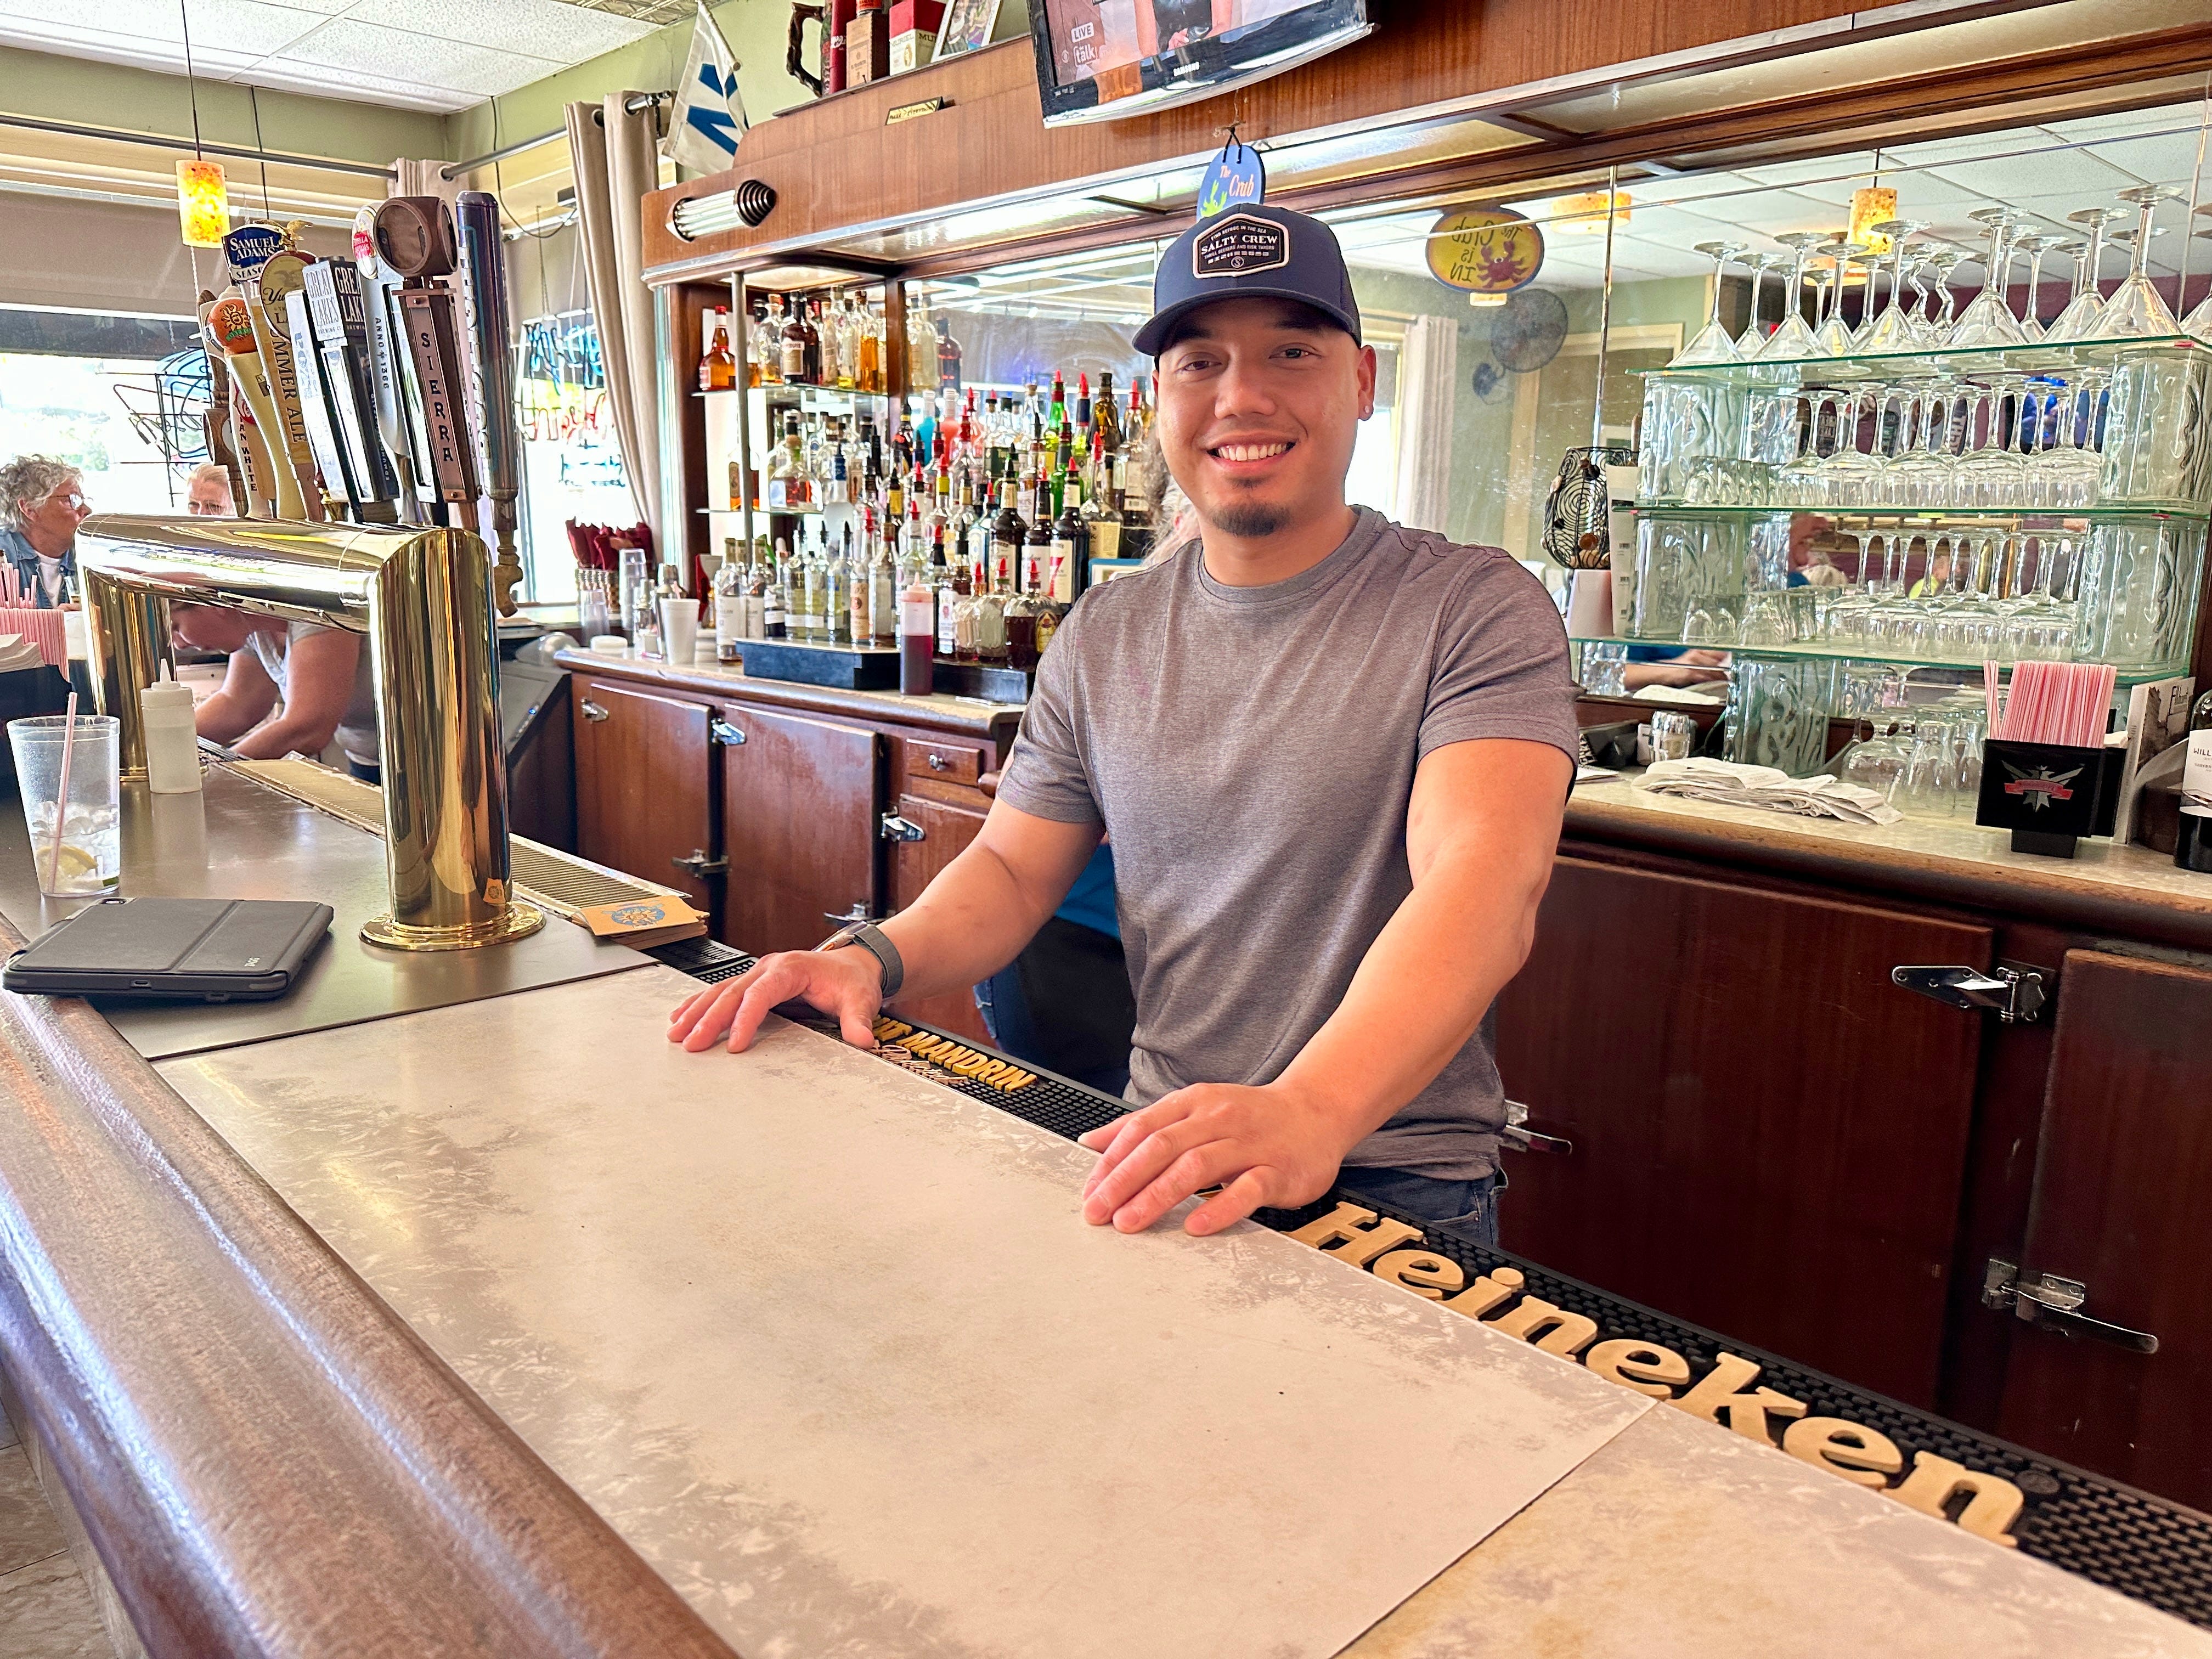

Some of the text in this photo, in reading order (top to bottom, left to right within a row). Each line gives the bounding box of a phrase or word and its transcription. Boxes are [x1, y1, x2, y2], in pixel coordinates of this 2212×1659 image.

[1074, 25, 1092, 40] LIVE
[1173, 63, 1200, 77] SAMSUNG
[230, 236, 280, 251] SAMUEL
[236, 247, 275, 261] ADAMS
[1201, 235, 1278, 255] SALTY CREW
[306, 268, 332, 298] GREAT
[312, 296, 339, 326] LAKES
[375, 318, 385, 348] ANNO
[269, 329, 298, 400] UMMER
[287, 407, 307, 443] ALE
[421, 332, 454, 462] SIERRA
[241, 446, 257, 492] WHITE
[896, 1031, 1037, 1094] MANDRIN
[1281, 1200, 2024, 1548] Heineken
